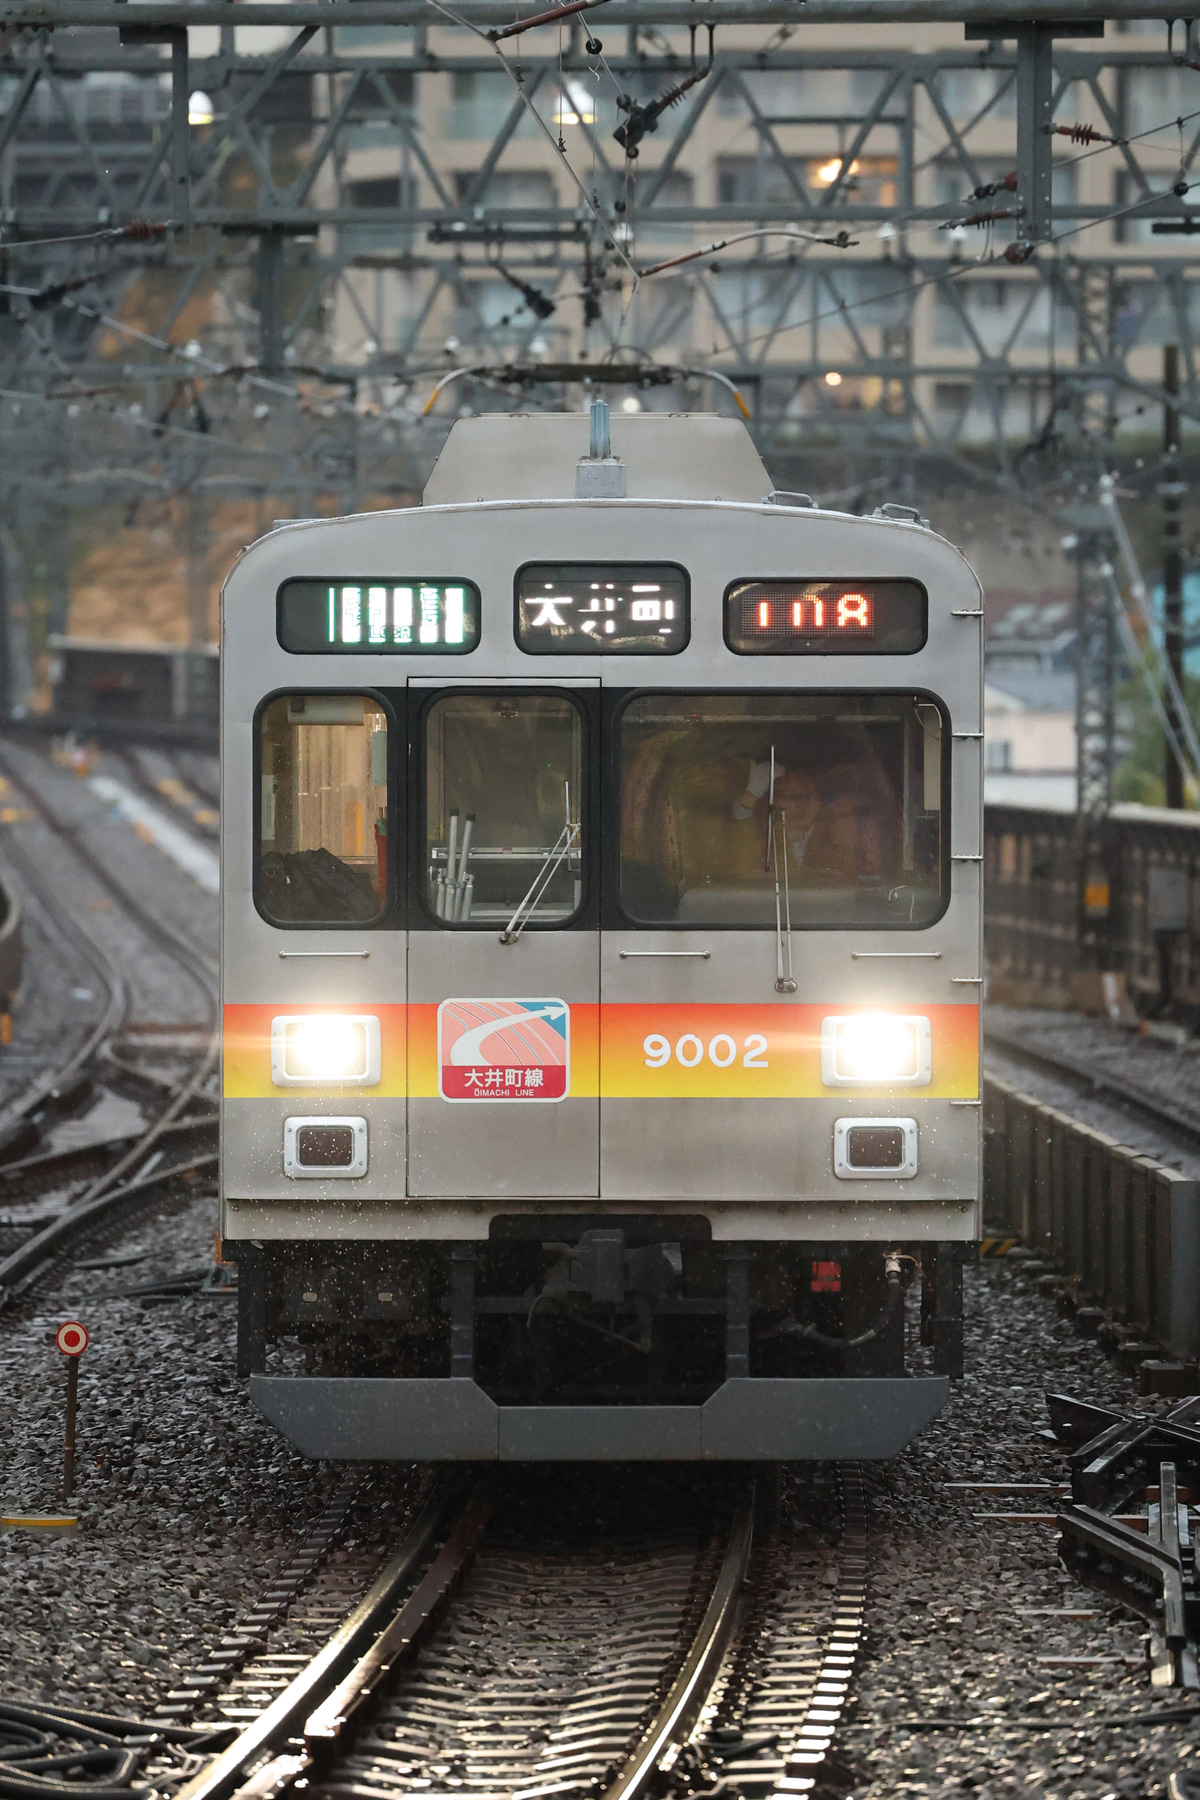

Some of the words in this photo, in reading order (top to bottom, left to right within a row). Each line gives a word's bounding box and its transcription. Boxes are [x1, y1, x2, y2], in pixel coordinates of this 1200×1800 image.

[643, 1033, 769, 1068] 9002
[464, 1068, 544, 1088] 大井町線
